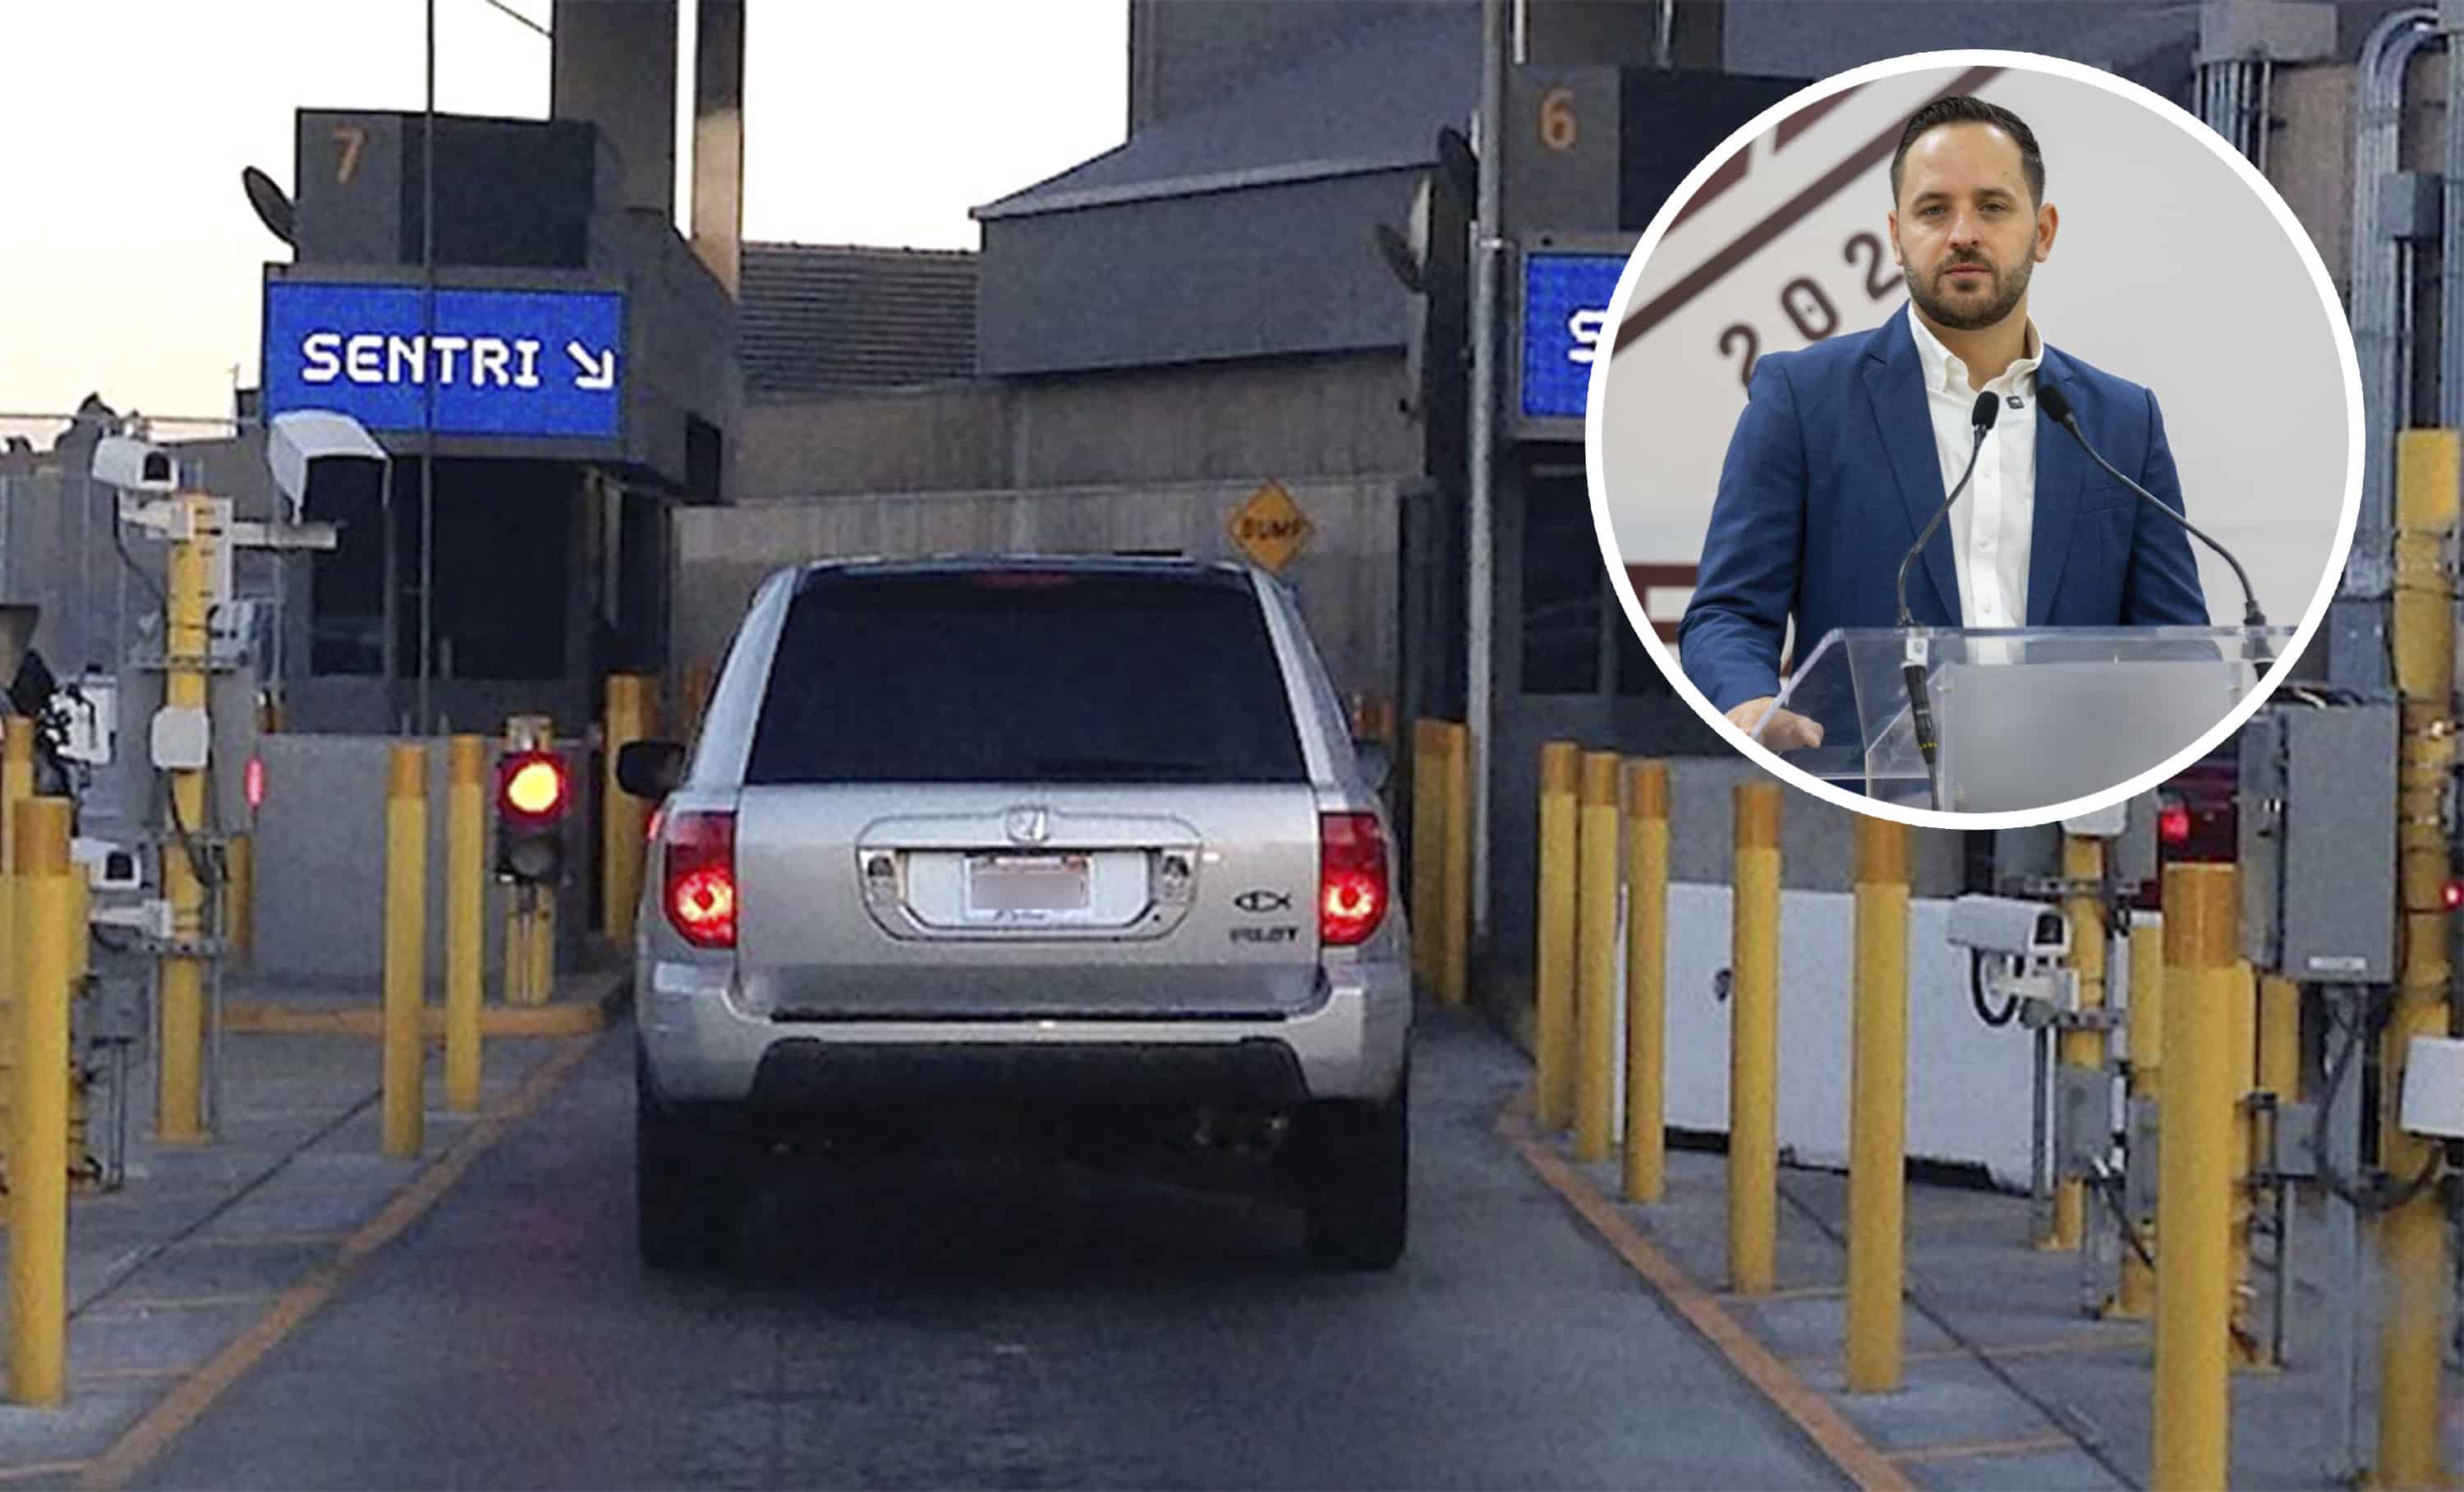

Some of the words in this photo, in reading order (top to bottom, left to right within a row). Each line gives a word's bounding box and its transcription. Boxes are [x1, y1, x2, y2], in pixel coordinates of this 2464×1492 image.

[1540, 88, 1577, 151] 6
[334, 127, 367, 184] 7
[302, 333, 539, 387] SENTRI
[1241, 517, 1302, 541] BUMP
